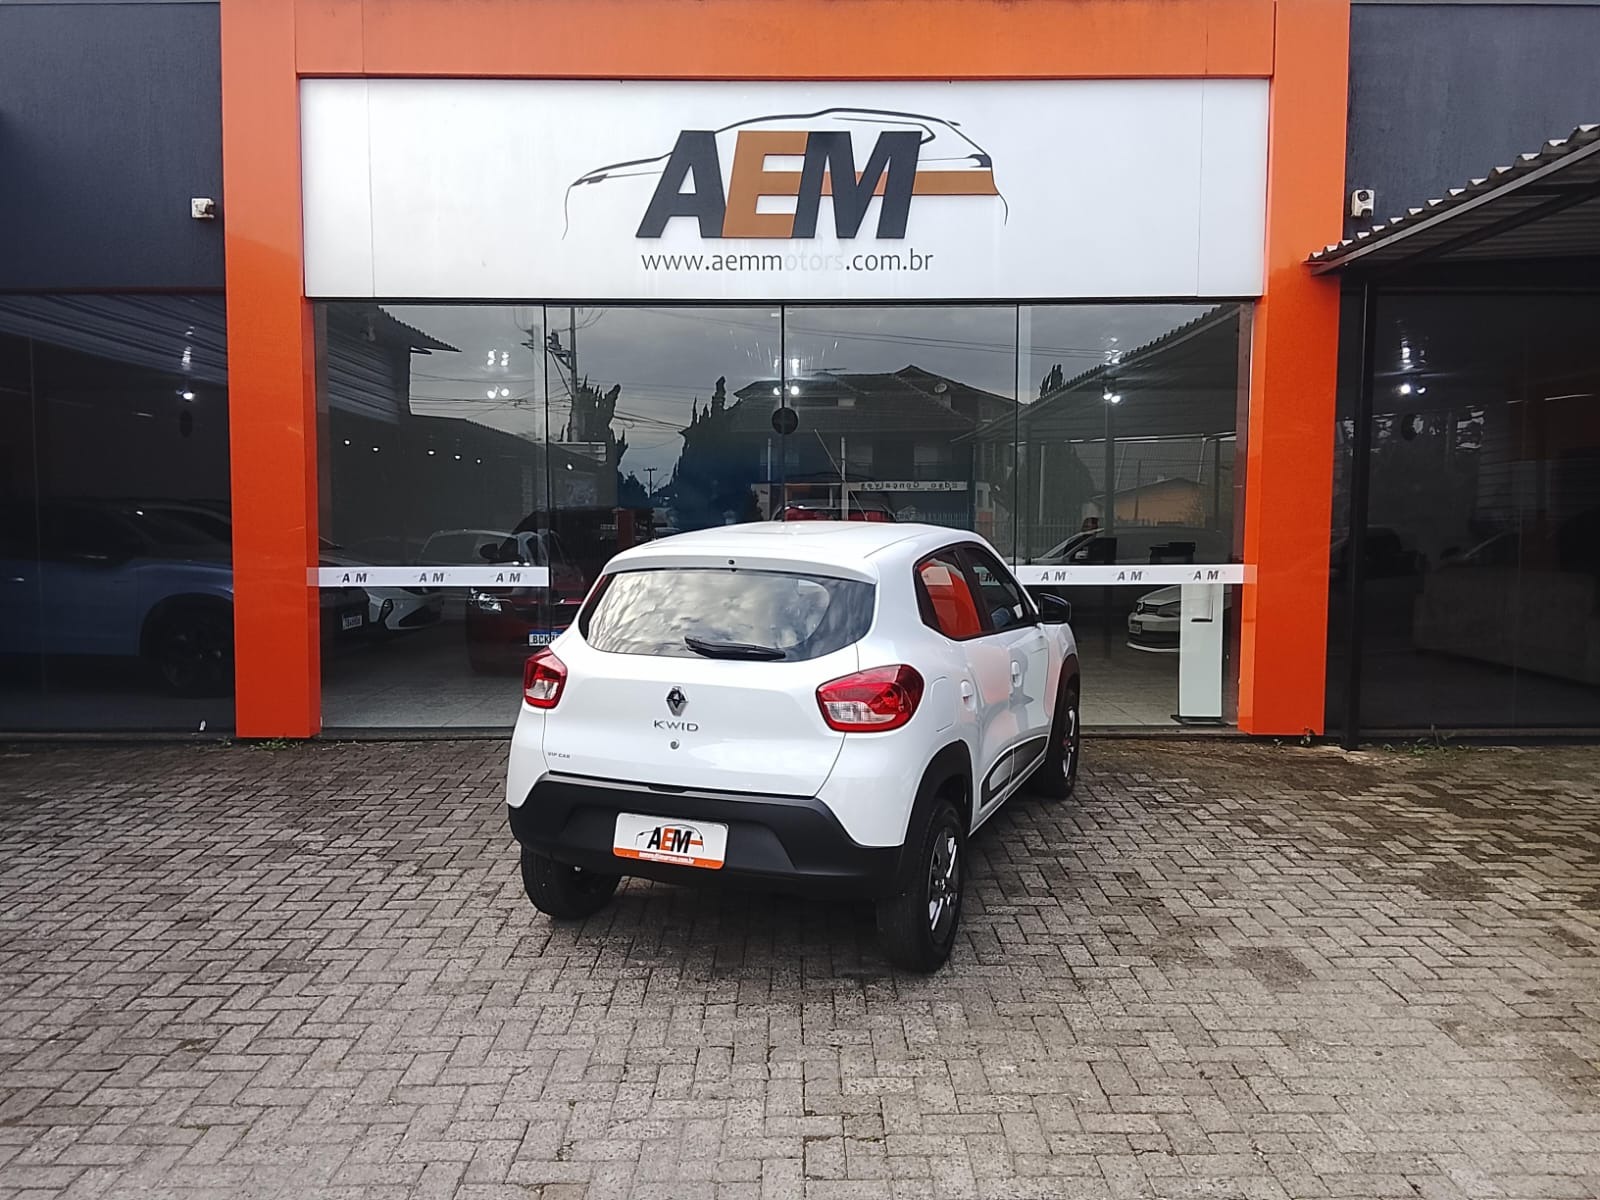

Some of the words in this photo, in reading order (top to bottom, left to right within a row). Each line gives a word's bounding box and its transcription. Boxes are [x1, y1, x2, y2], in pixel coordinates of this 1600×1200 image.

[635, 130, 923, 240] AEM
[641, 248, 934, 271] www.aemmotors.com.br
[654, 720, 698, 731] KWID
[647, 827, 692, 853] AEM
